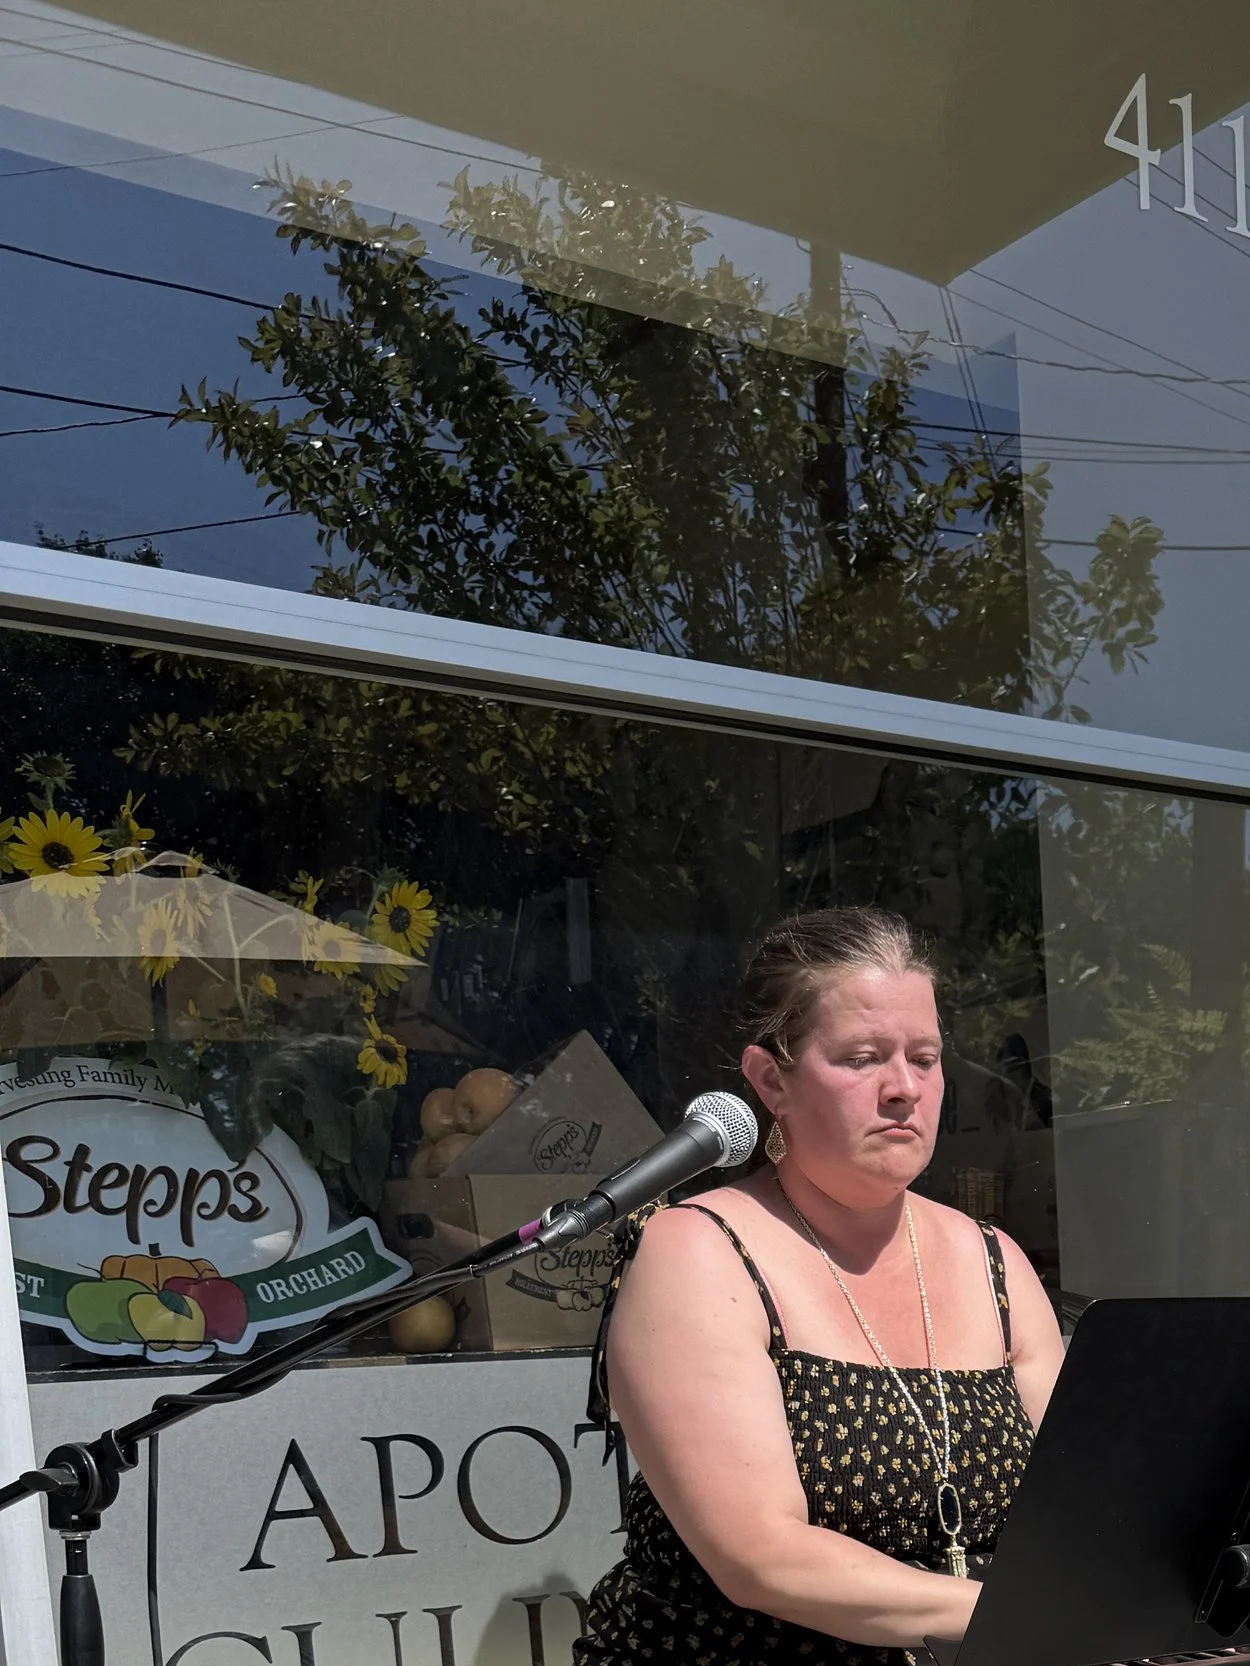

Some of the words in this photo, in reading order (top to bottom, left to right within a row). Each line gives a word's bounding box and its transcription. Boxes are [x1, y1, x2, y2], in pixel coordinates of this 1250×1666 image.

[76, 1064, 148, 1093] Family
[2, 1134, 270, 1248] Stepp's
[255, 1250, 367, 1304] ORCHARD
